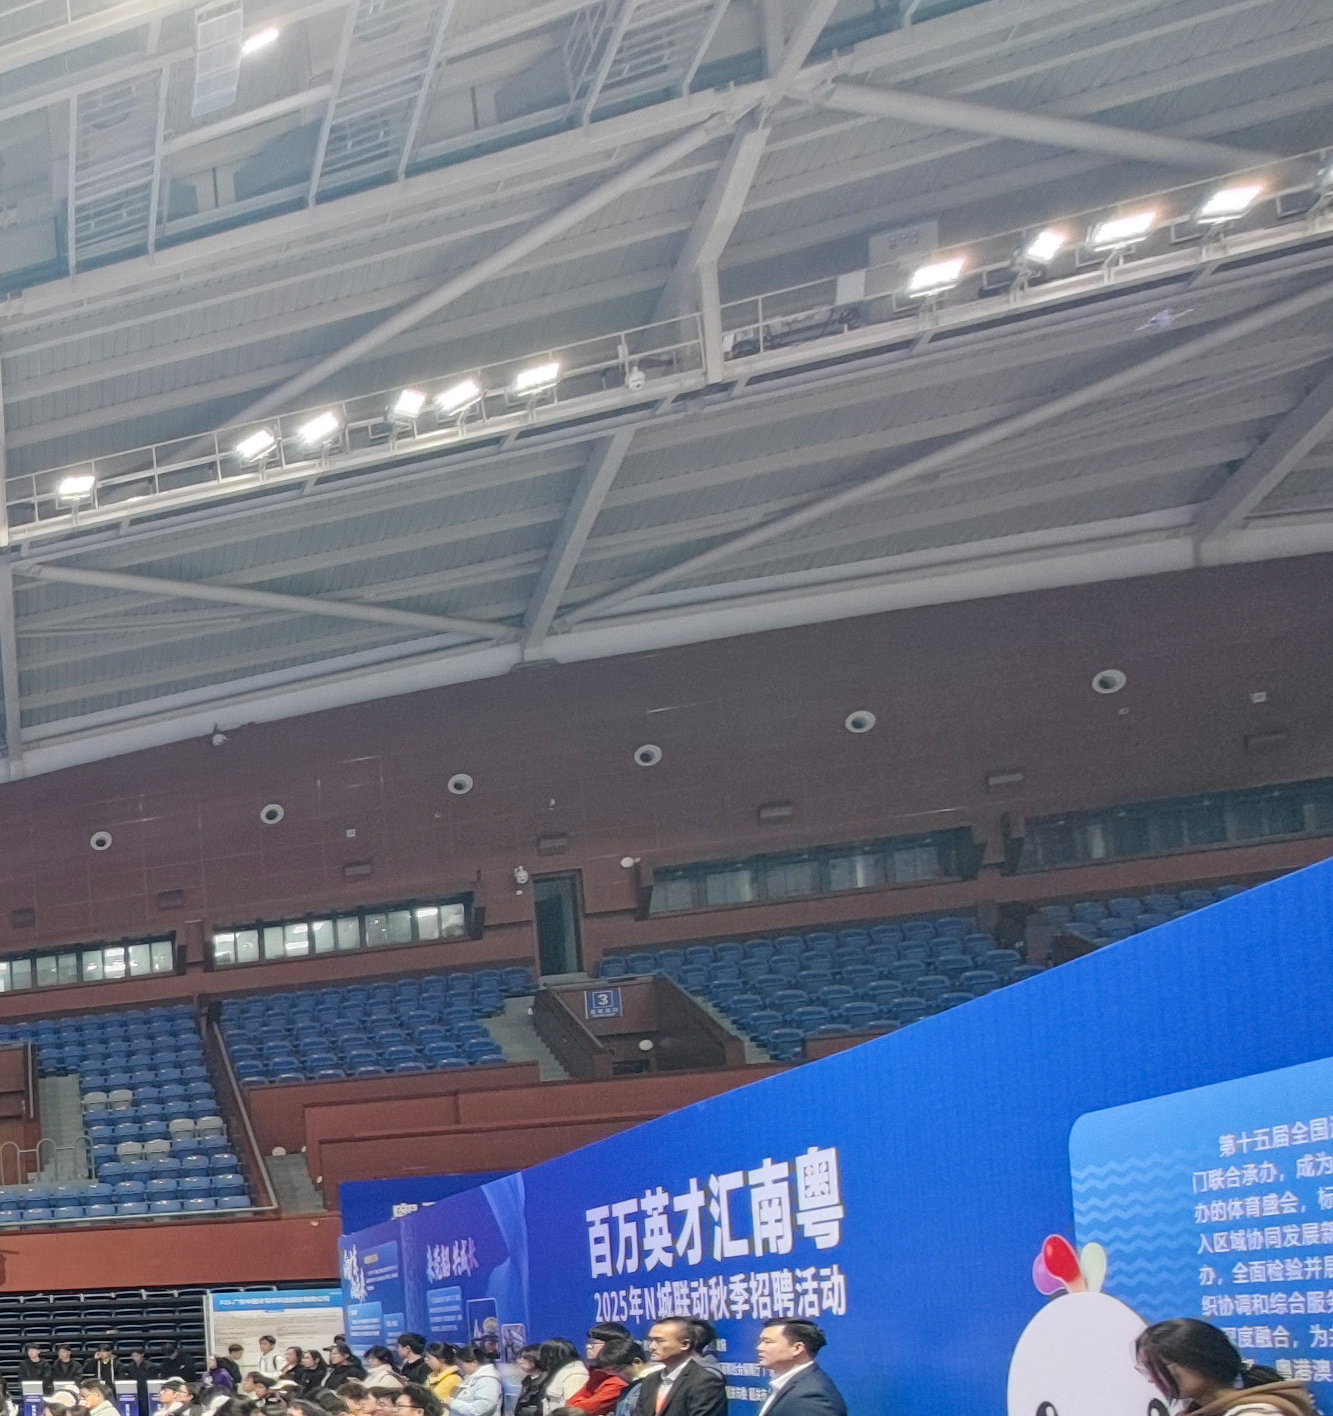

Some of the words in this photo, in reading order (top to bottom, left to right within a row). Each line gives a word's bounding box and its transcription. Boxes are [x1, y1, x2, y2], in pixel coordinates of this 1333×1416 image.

[597, 993, 609, 1006] 3
[585, 1145, 845, 1279] 百万英才汇南粤
[593, 1264, 847, 1324] 2025年N城联动秋季招聘活动
[1276, 1358, 1333, 1383] 粤港澳
